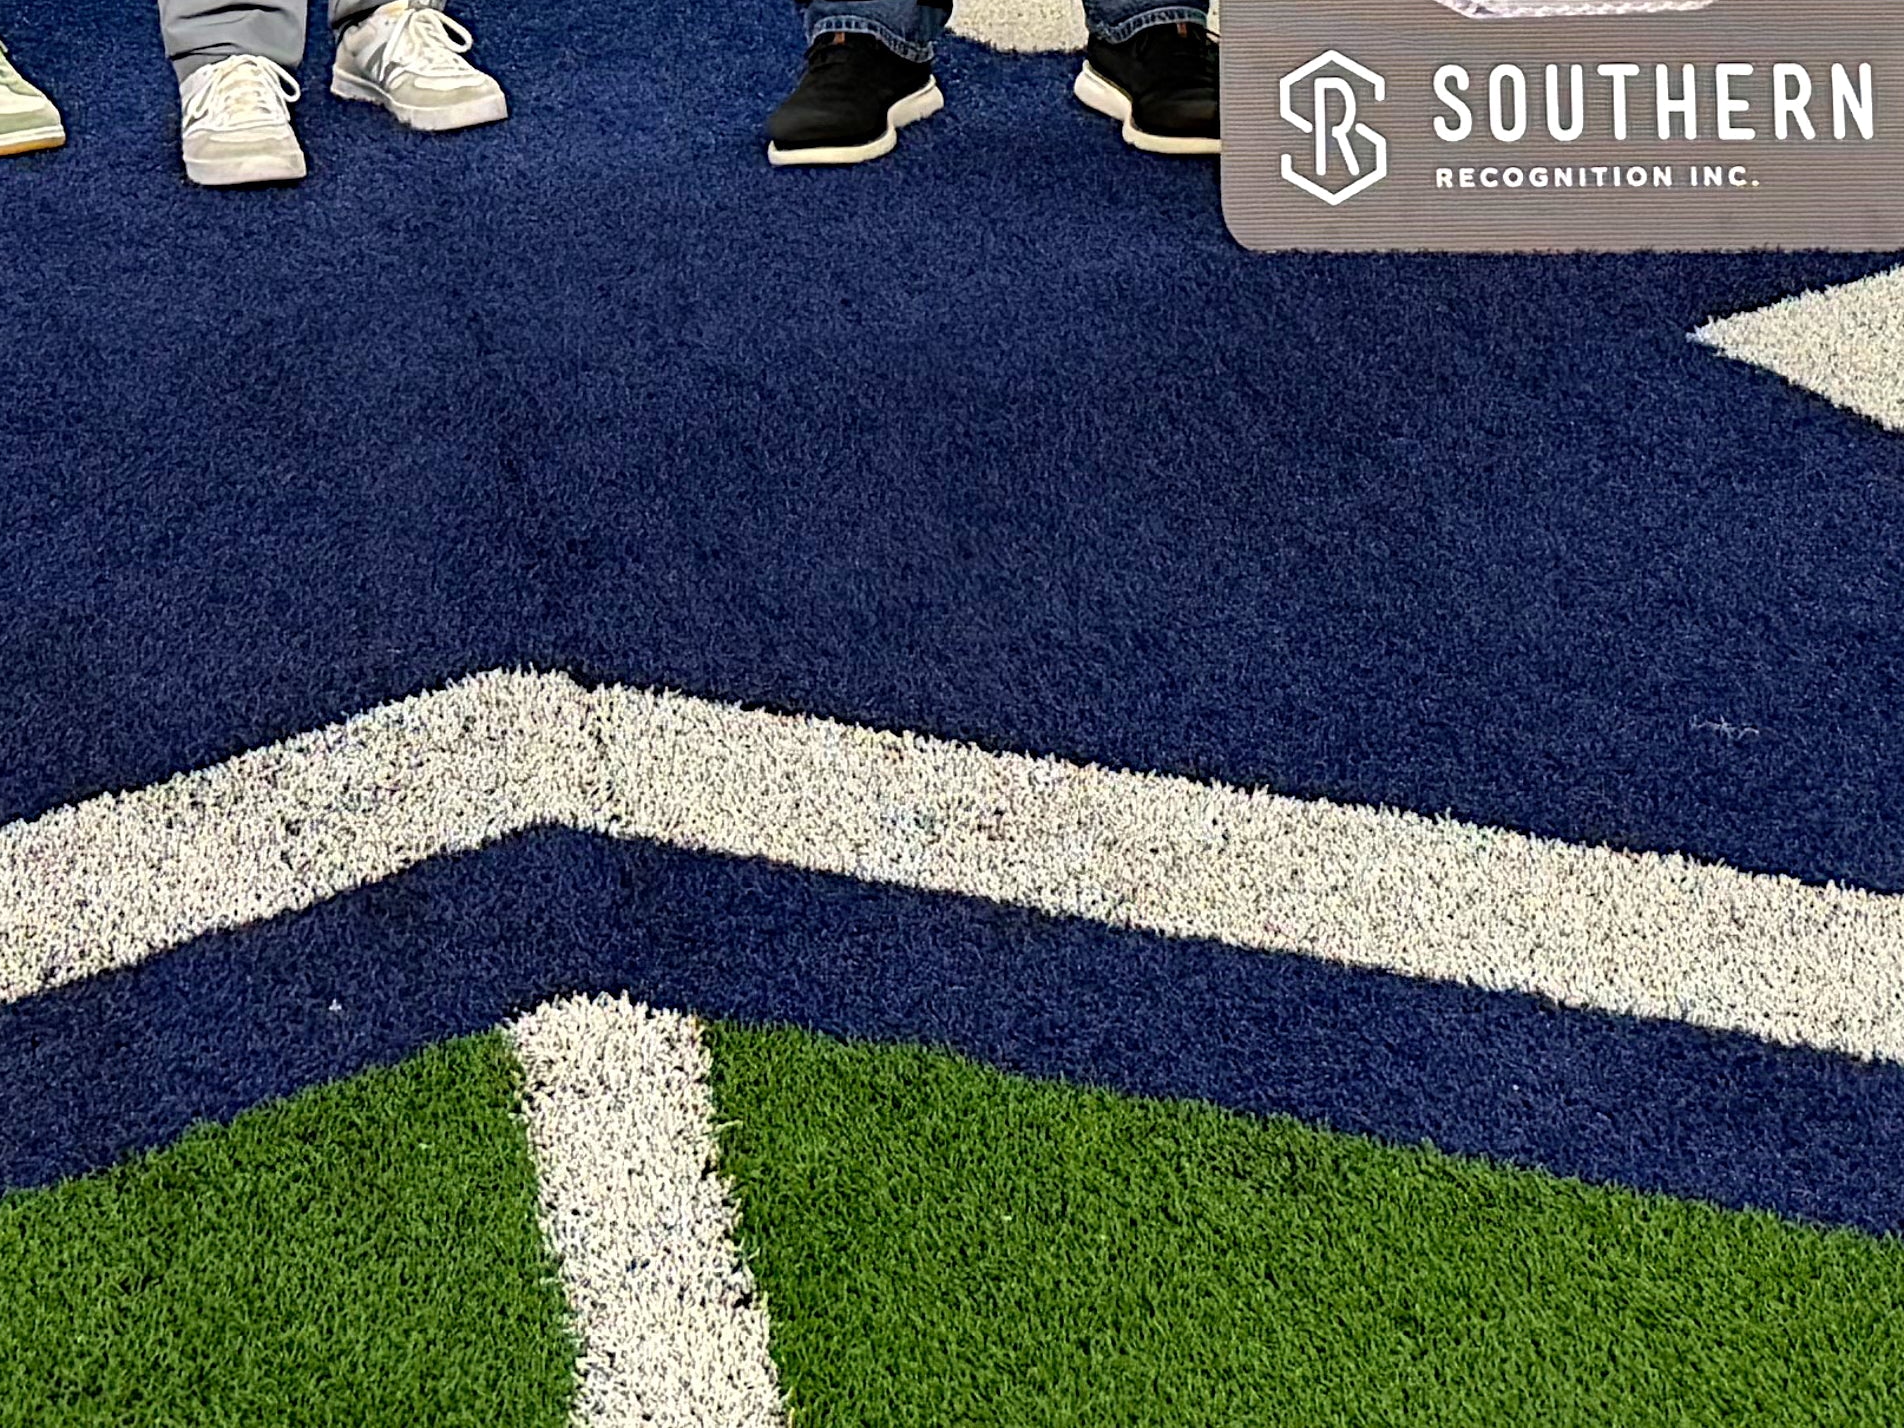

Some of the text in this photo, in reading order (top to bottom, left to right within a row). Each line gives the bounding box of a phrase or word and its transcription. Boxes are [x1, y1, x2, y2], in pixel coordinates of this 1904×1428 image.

[1433, 60, 1876, 142] SOUTHERN
[1436, 164, 1761, 189] RECOGNITION INC.
